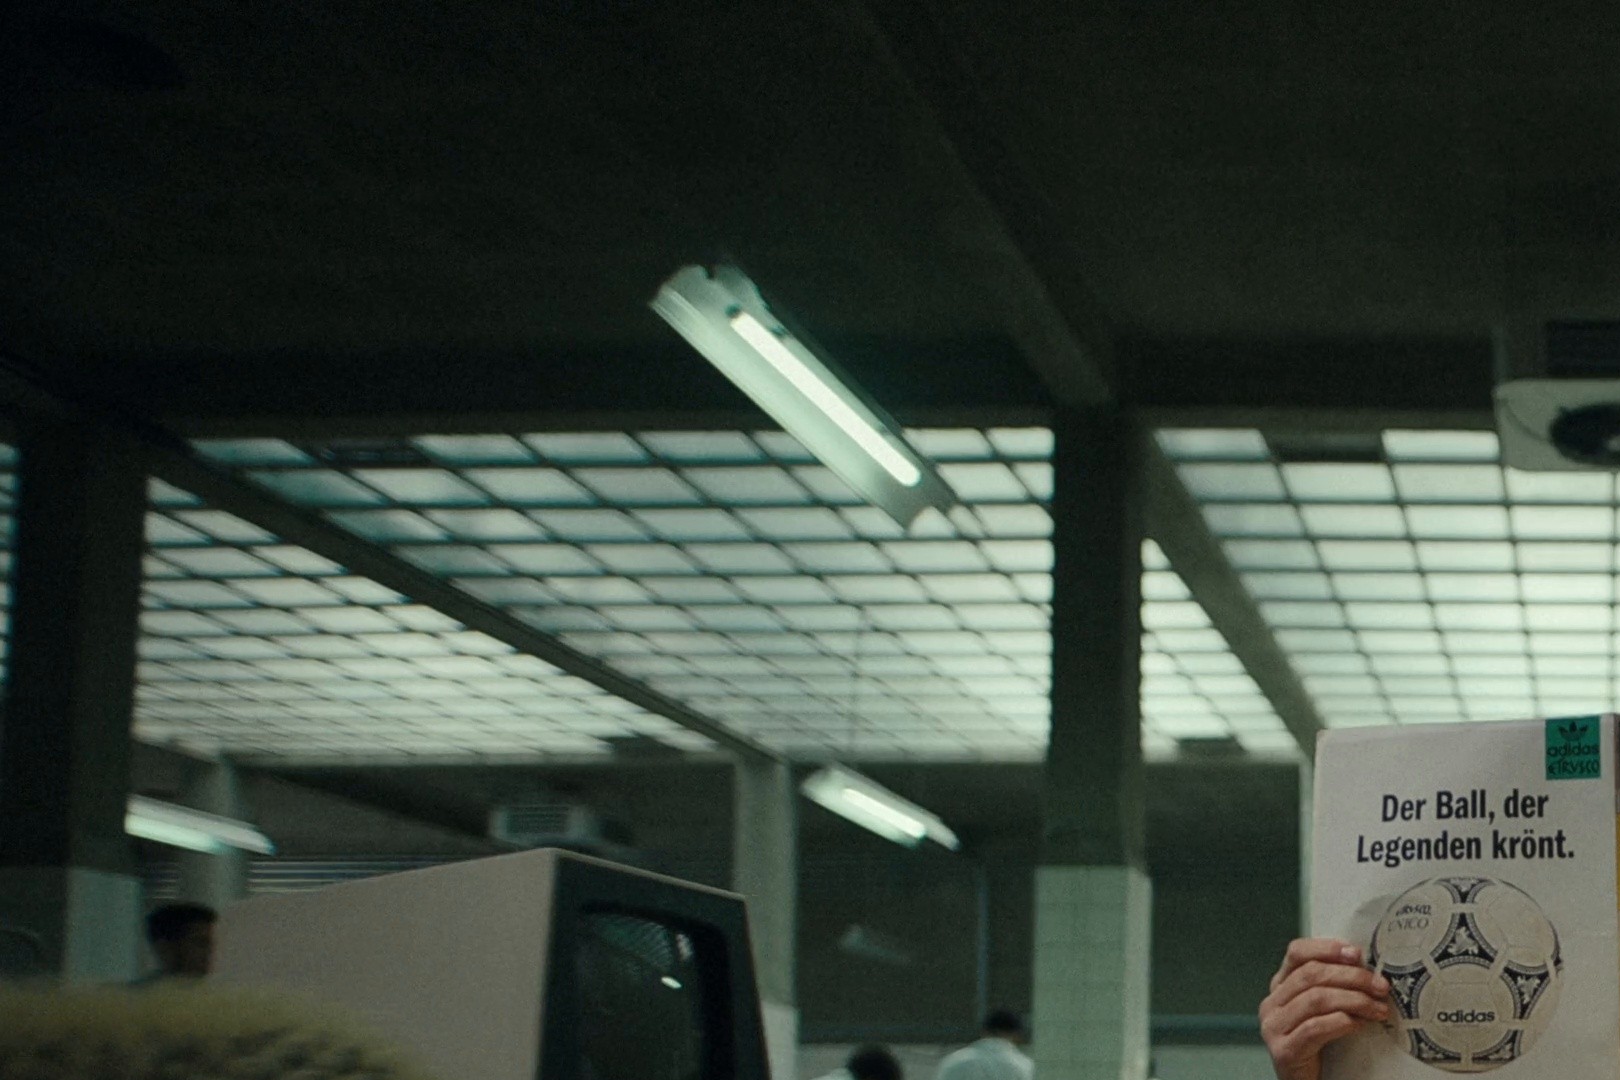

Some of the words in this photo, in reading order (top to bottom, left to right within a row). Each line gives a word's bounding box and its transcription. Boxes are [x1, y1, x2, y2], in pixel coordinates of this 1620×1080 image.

[1547, 741, 1600, 757] adidas
[1382, 794, 1426, 822] Der
[1436, 789, 1495, 825] Ball,
[1504, 788, 1549, 818] der
[1357, 830, 1482, 868] Legenden
[1492, 829, 1574, 860] krönt.
[1436, 1009, 1495, 1023] adidas
